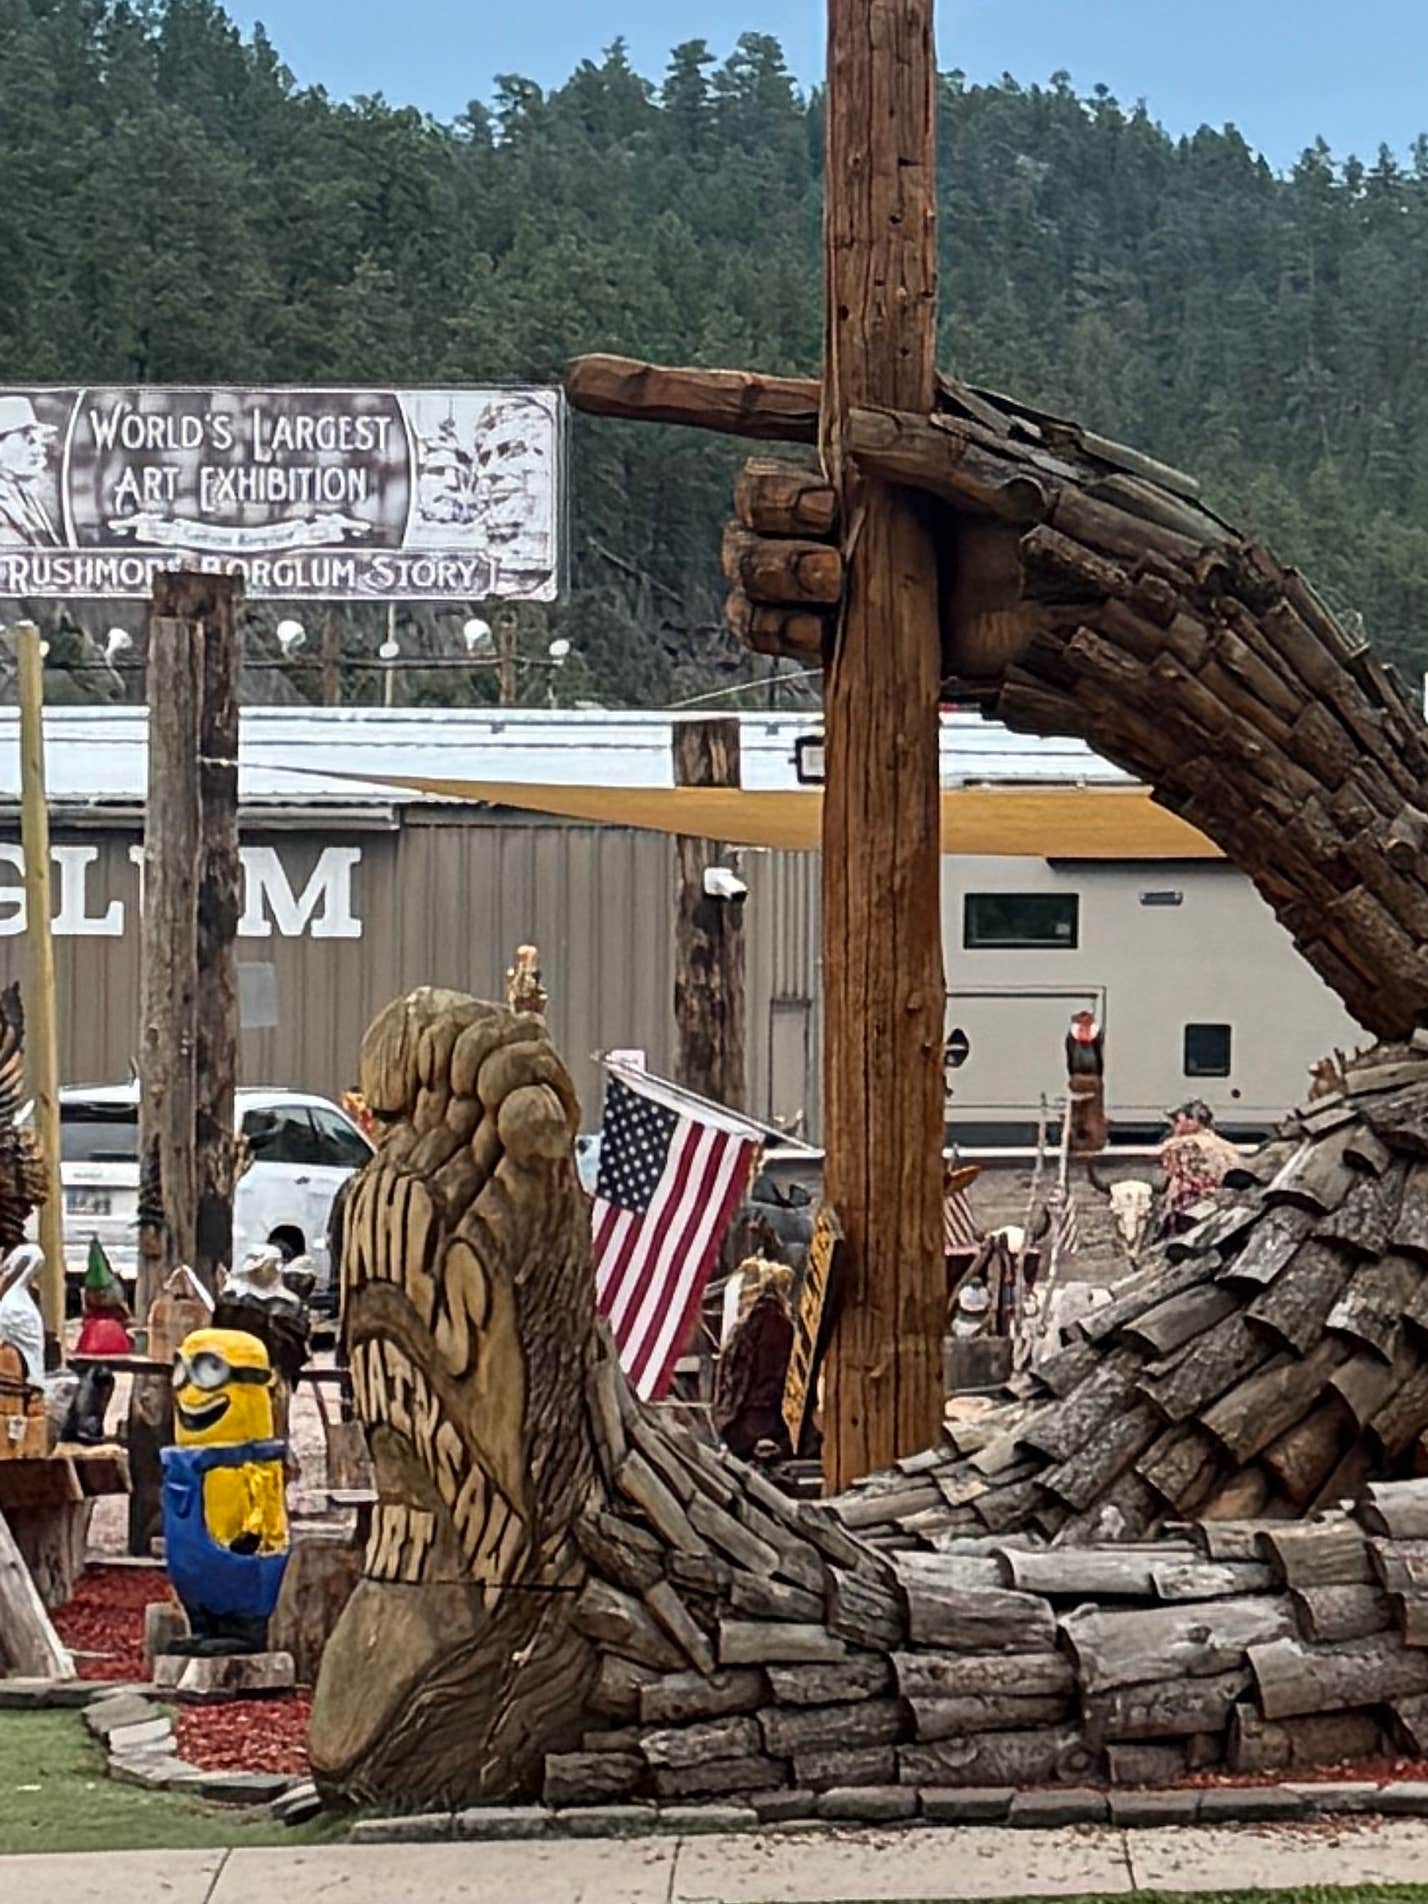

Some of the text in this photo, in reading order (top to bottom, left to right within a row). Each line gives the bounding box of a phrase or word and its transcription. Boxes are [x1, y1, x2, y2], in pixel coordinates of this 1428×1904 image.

[89, 400, 392, 462] WORLD'S LARGEST
[113, 466, 367, 514] ART EXHIBITION
[360, 553, 478, 588] STORY
